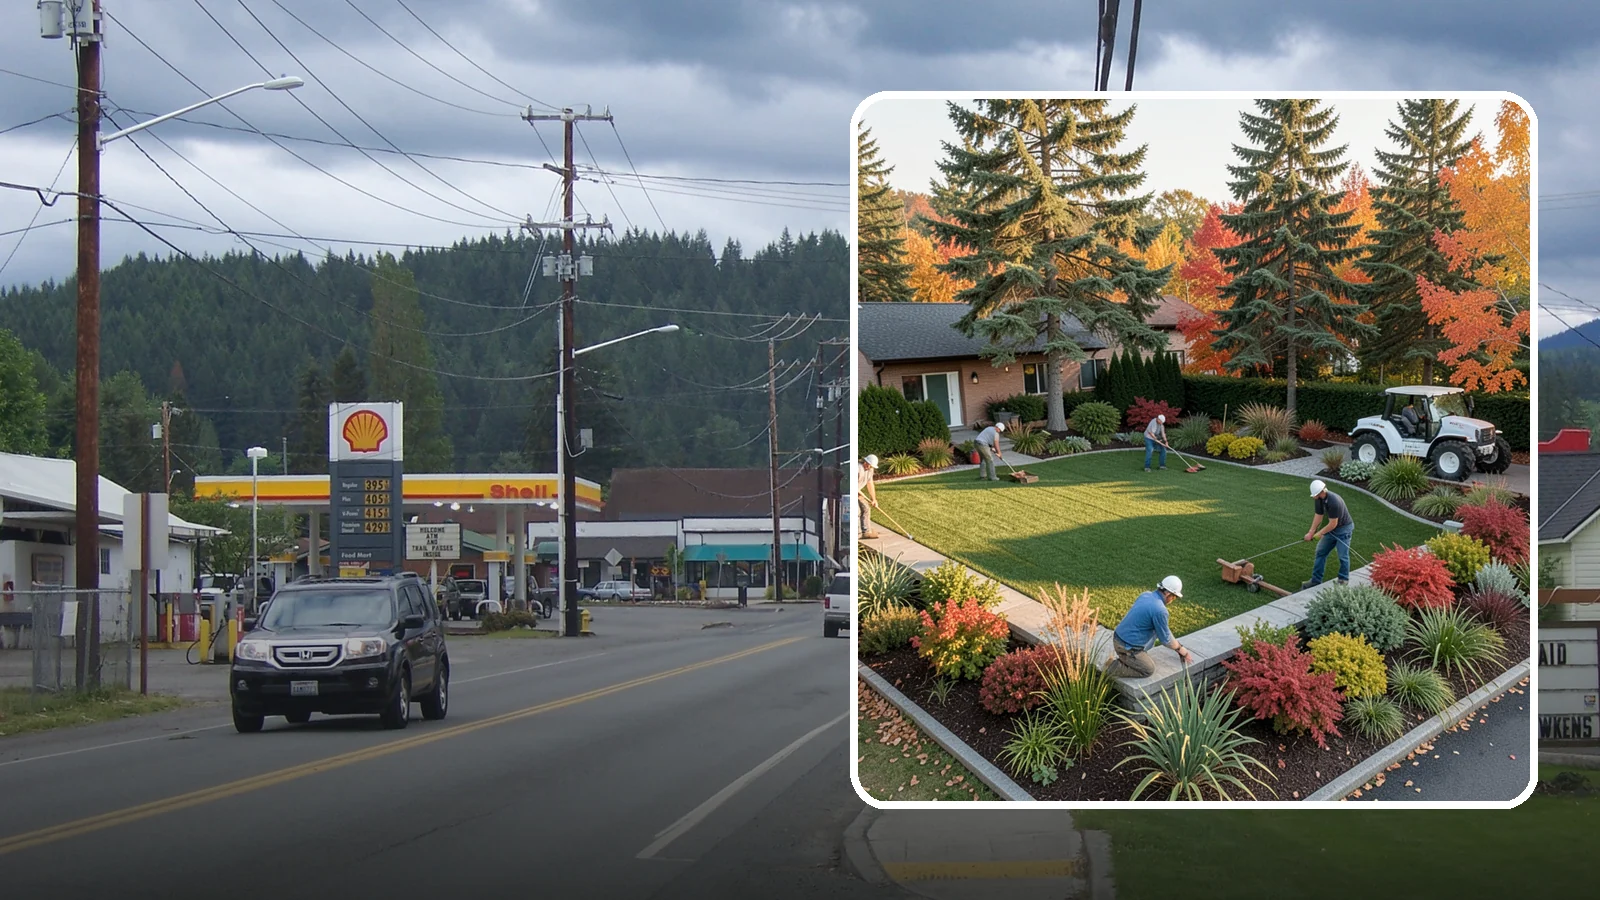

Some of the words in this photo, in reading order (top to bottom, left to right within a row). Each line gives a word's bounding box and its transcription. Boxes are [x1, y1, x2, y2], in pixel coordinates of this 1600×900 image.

[366, 480, 383, 490] 395
[490, 484, 548, 499] Shell
[366, 494, 383, 504] 405
[366, 508, 383, 518] 415
[366, 522, 383, 532] 429
[1539, 643, 1567, 666] AID
